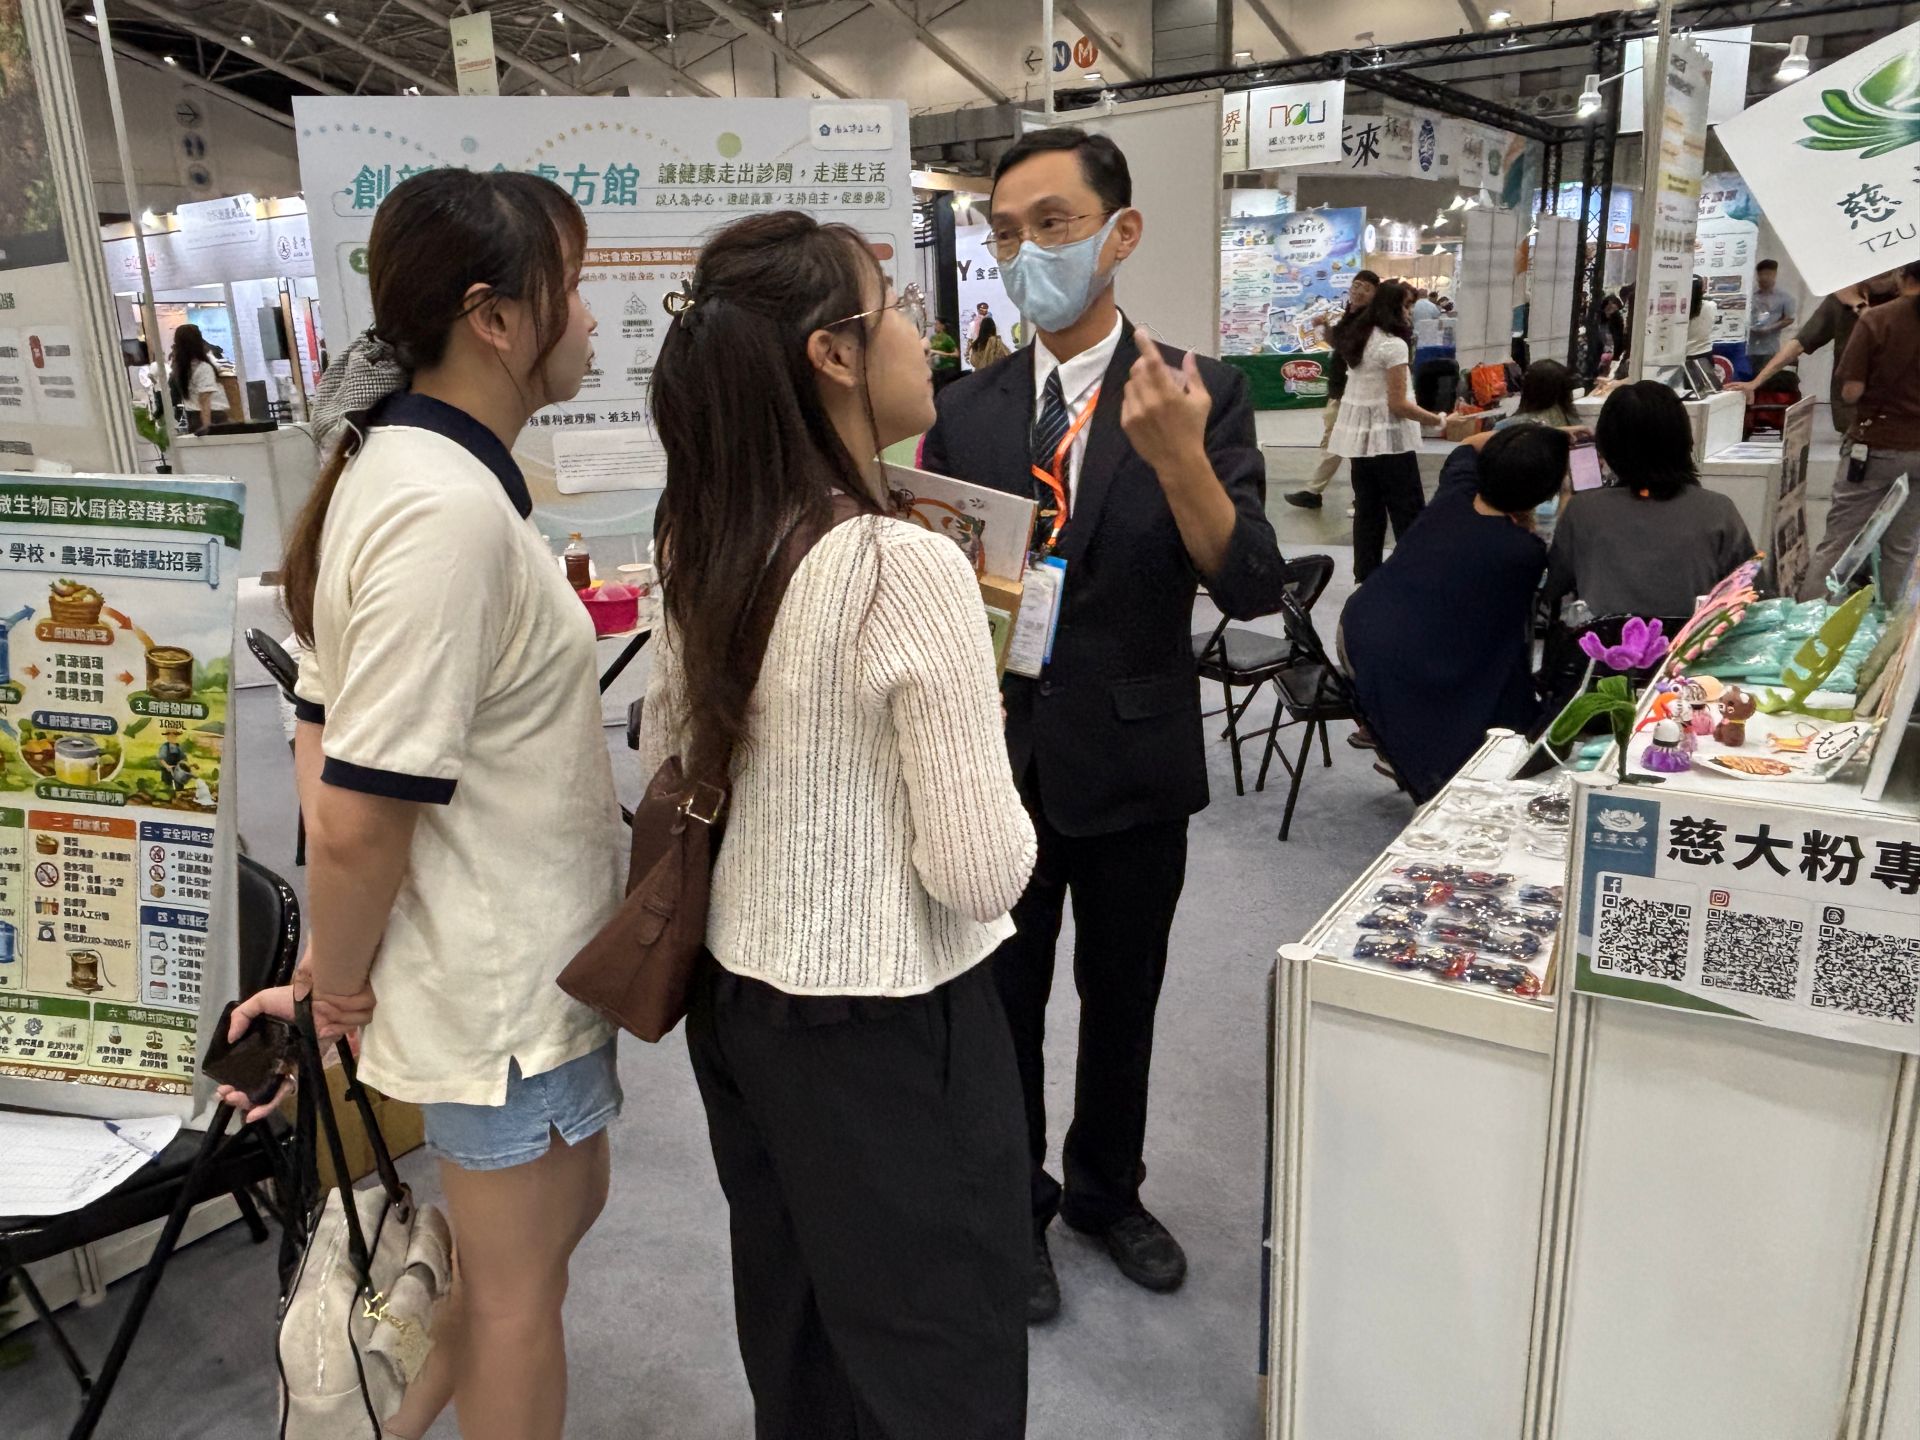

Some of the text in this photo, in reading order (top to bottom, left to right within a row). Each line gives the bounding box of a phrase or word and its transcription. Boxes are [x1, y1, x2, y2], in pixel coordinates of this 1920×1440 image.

[1858, 223, 1917, 252] TZU
[1667, 815, 1920, 895] 慈大粉專
